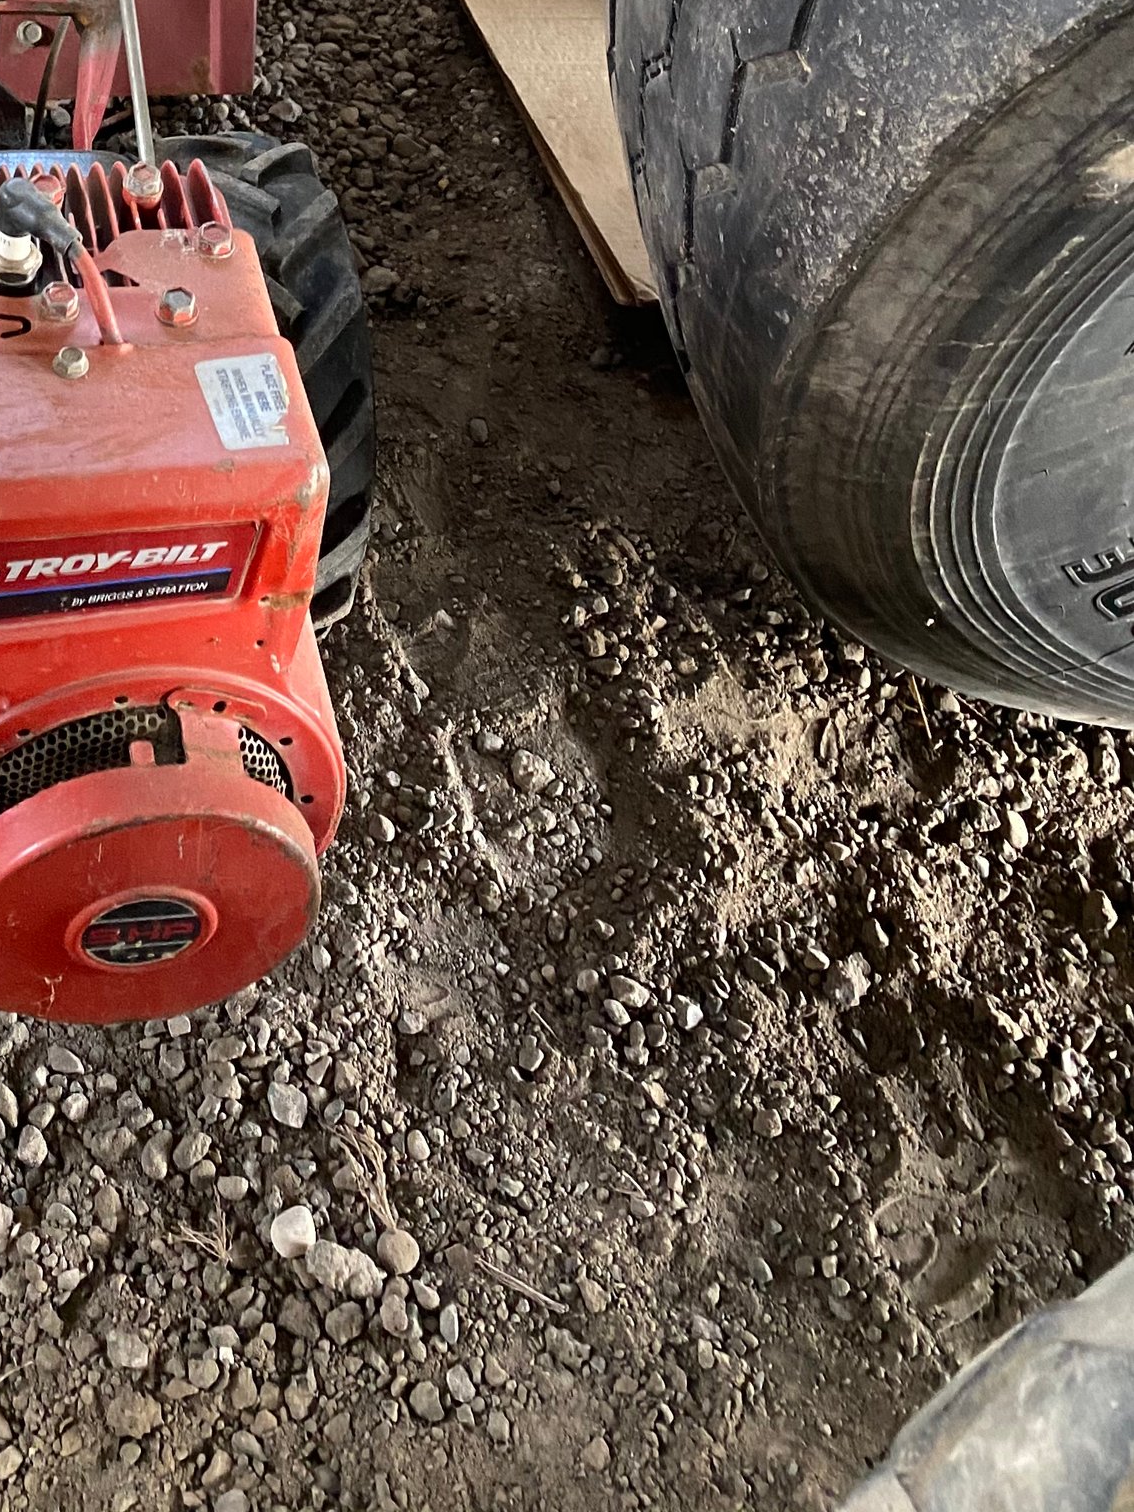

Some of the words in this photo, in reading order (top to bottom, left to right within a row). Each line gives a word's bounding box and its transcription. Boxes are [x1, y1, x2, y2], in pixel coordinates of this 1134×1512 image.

[4, 541, 228, 581] TROY-BILT
[88, 590, 134, 604] BRIGGS
[135, 588, 144, 599] &
[146, 581, 209, 598] STRATTON
